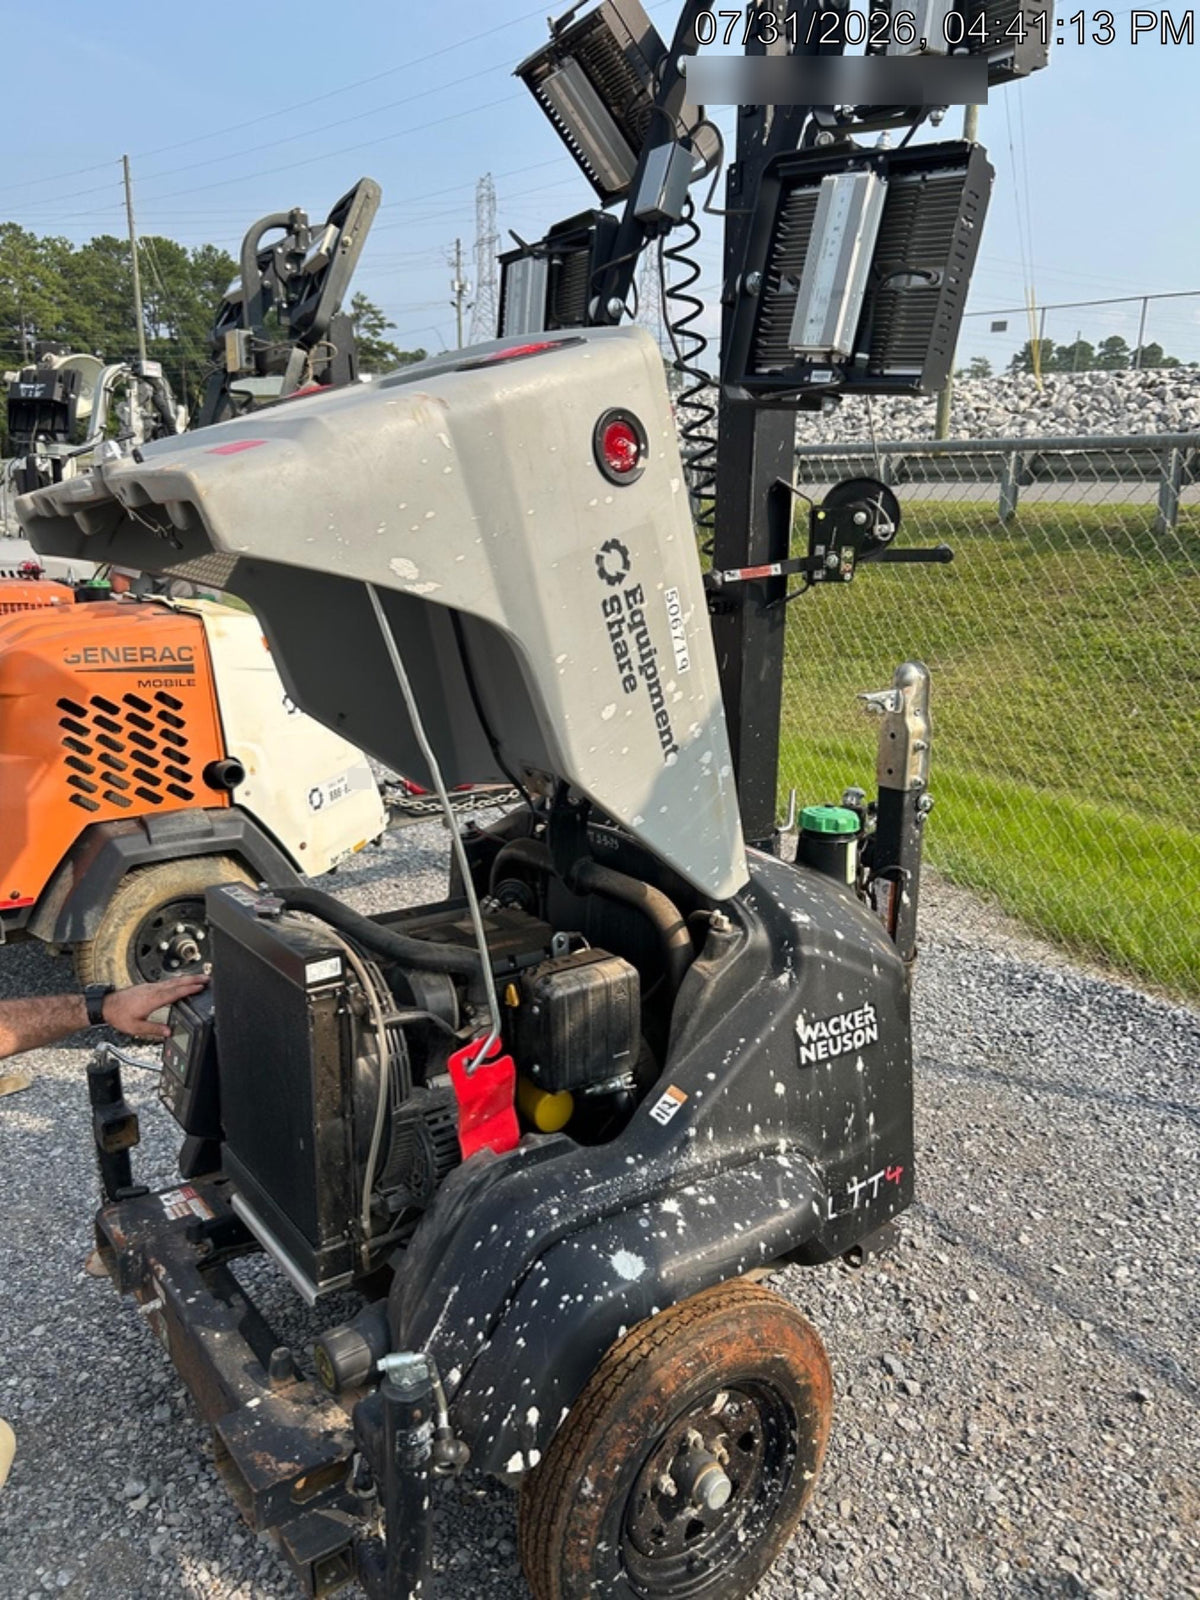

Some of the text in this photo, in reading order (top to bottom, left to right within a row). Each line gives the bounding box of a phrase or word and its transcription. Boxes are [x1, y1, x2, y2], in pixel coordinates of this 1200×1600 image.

[601, 594, 639, 695] Share
[665, 589, 690, 672] 506719
[137, 678, 197, 689] MOBILE
[623, 583, 680, 764] Equipment
[795, 1003, 877, 1045] WACKER
[799, 1023, 879, 1066] NEUSON
